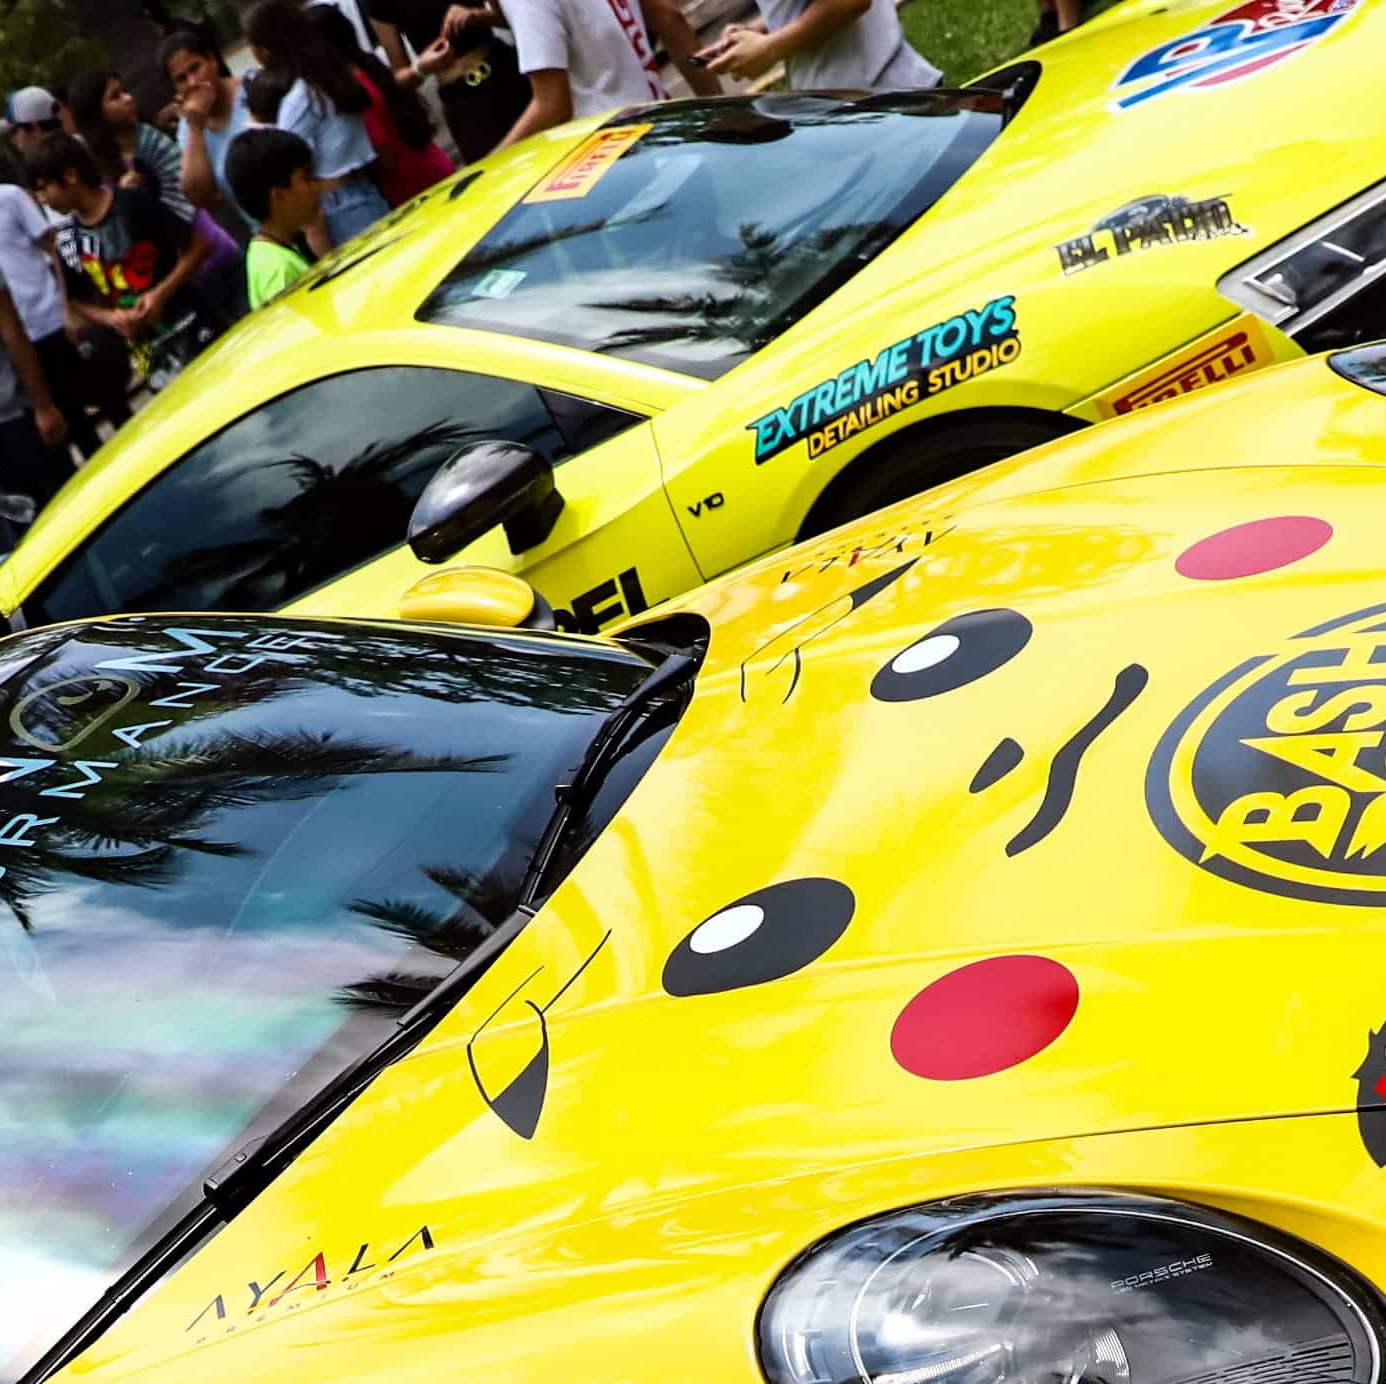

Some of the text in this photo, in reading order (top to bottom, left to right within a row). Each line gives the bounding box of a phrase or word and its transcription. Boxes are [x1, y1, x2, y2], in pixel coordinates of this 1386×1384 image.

[1055, 233, 1110, 273] EL
[750, 295, 1015, 458] EXTREME TOYS
[809, 336, 1022, 457] DETAILING STUDIO
[1112, 331, 1256, 416] PRELLI
[686, 491, 725, 517] V10
[1111, 1253, 1212, 1289] PORSCHE
